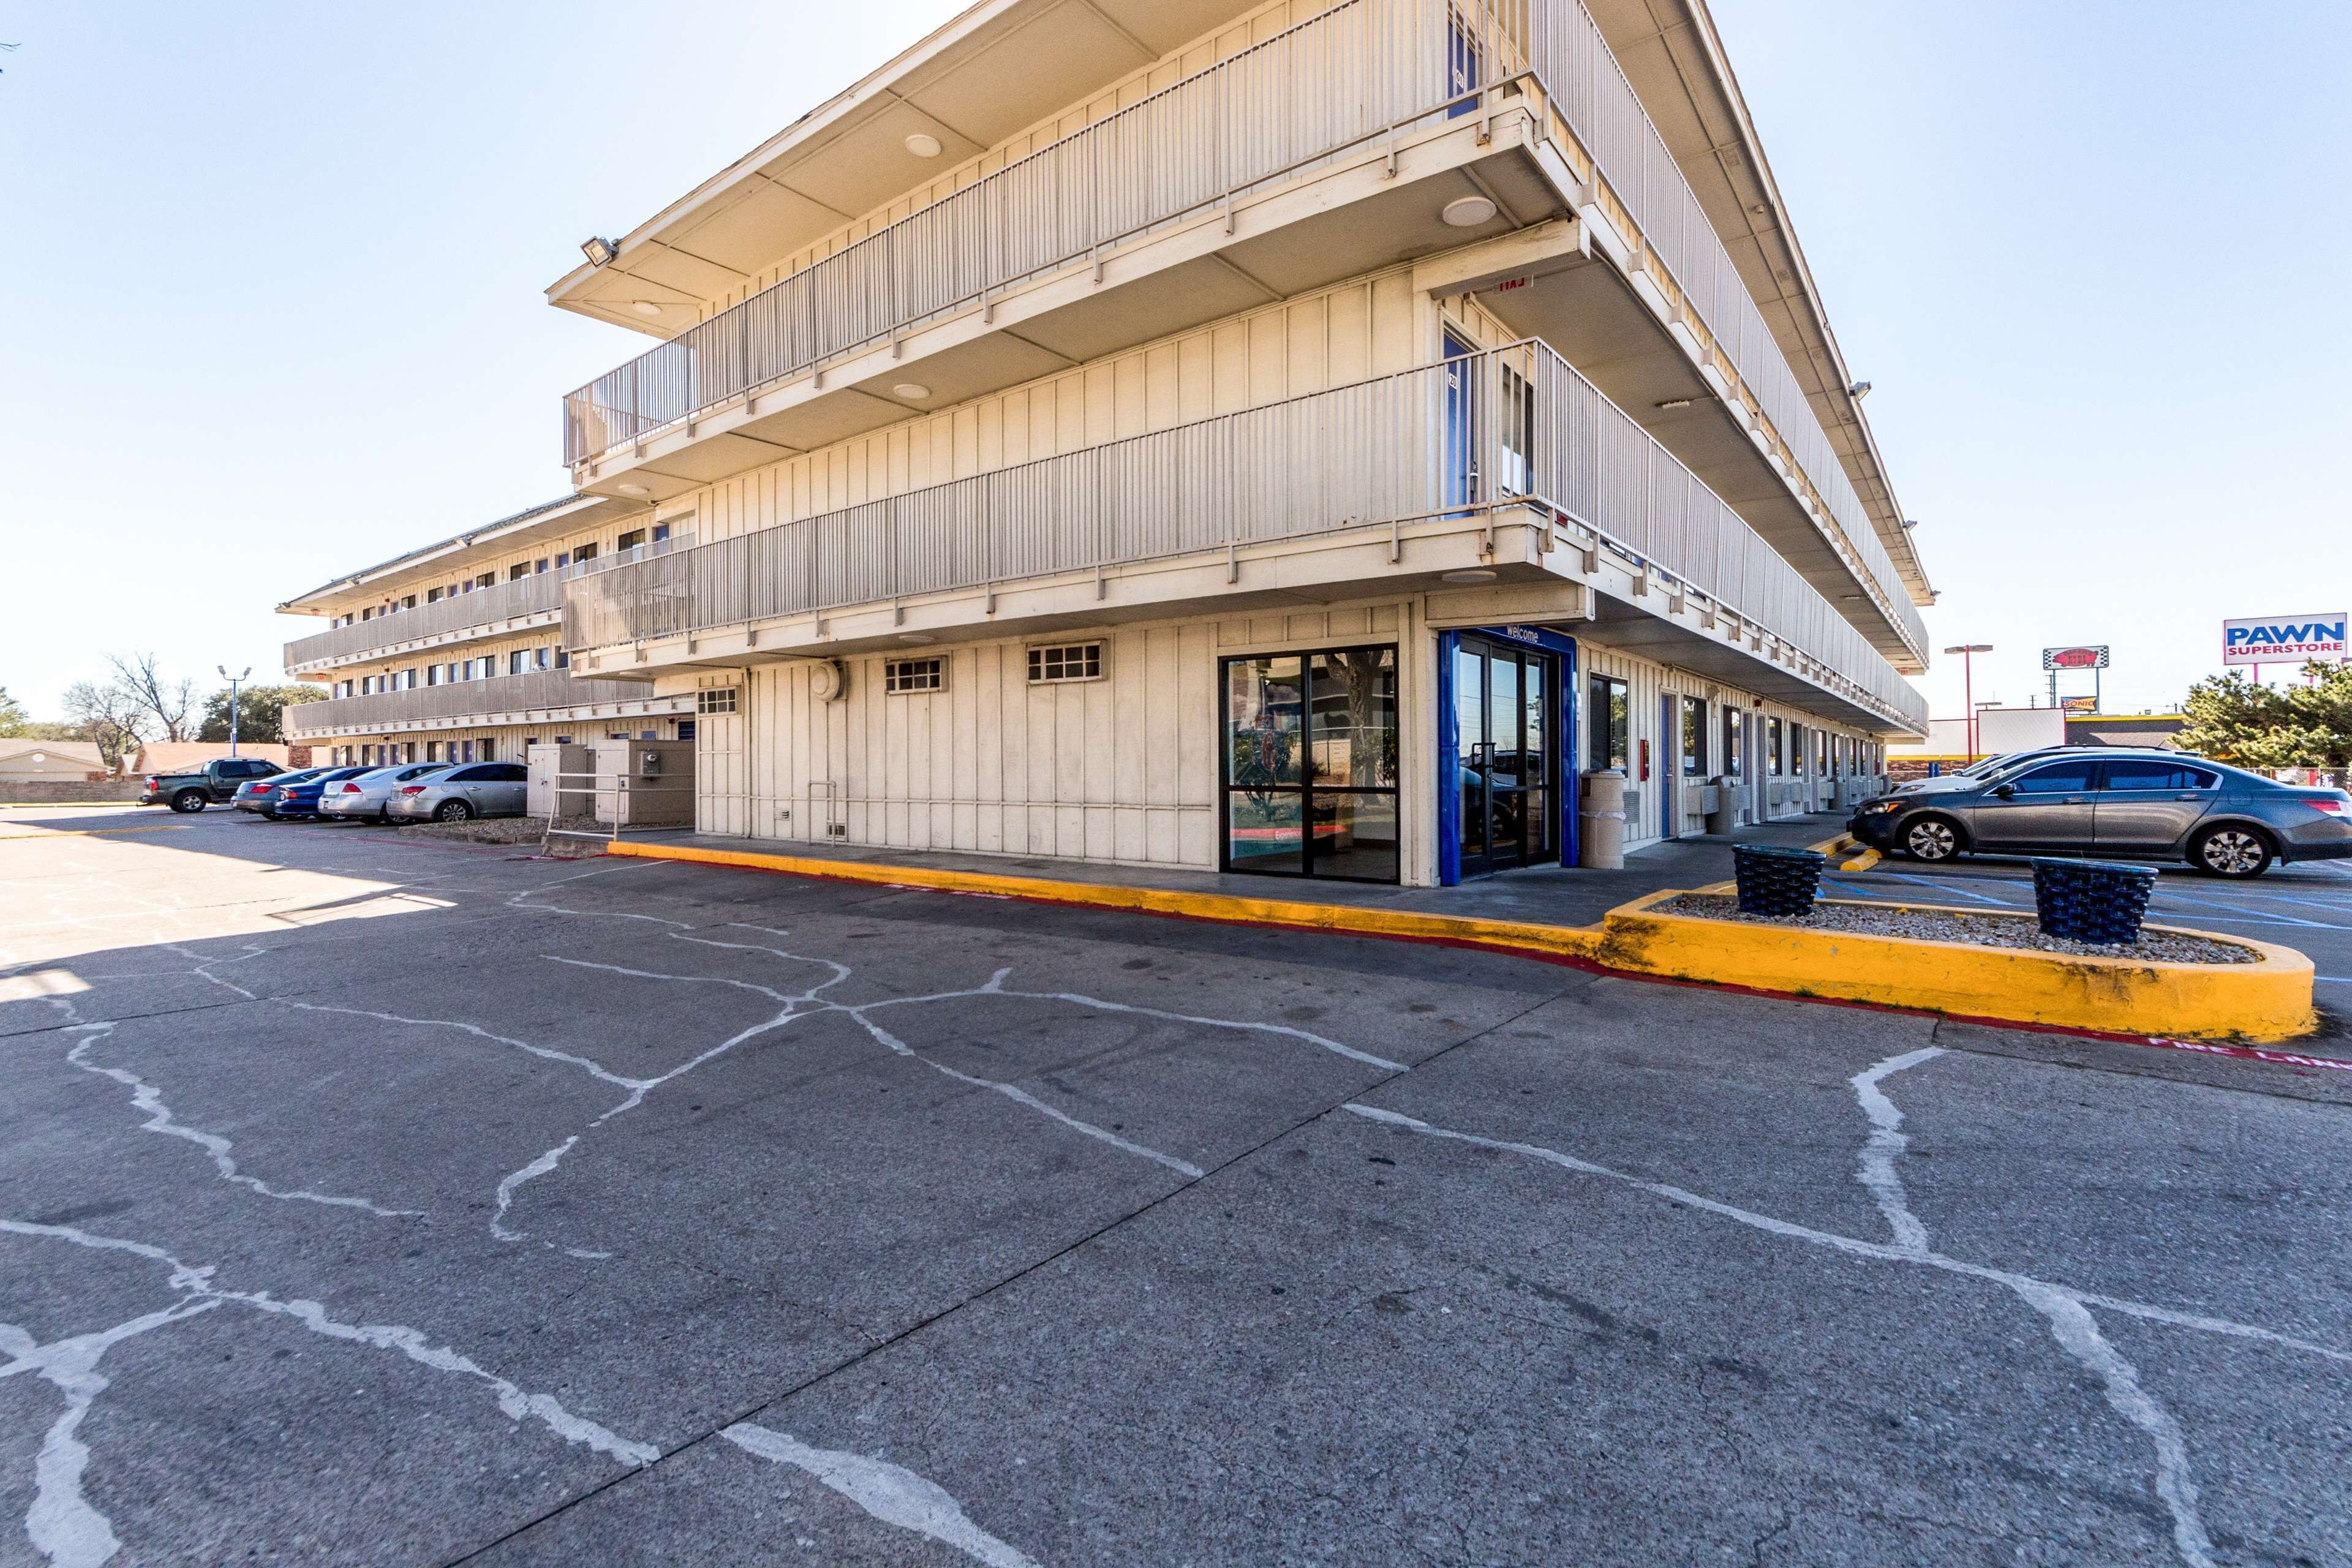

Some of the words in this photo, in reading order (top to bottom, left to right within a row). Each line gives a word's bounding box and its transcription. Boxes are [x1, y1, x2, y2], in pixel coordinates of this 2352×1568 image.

[1507, 624, 1539, 643] welcome
[2227, 622, 2344, 646] PAWN
[2228, 643, 2343, 656] SUPERSTORE
[2148, 1038, 2235, 1055] FIRE
